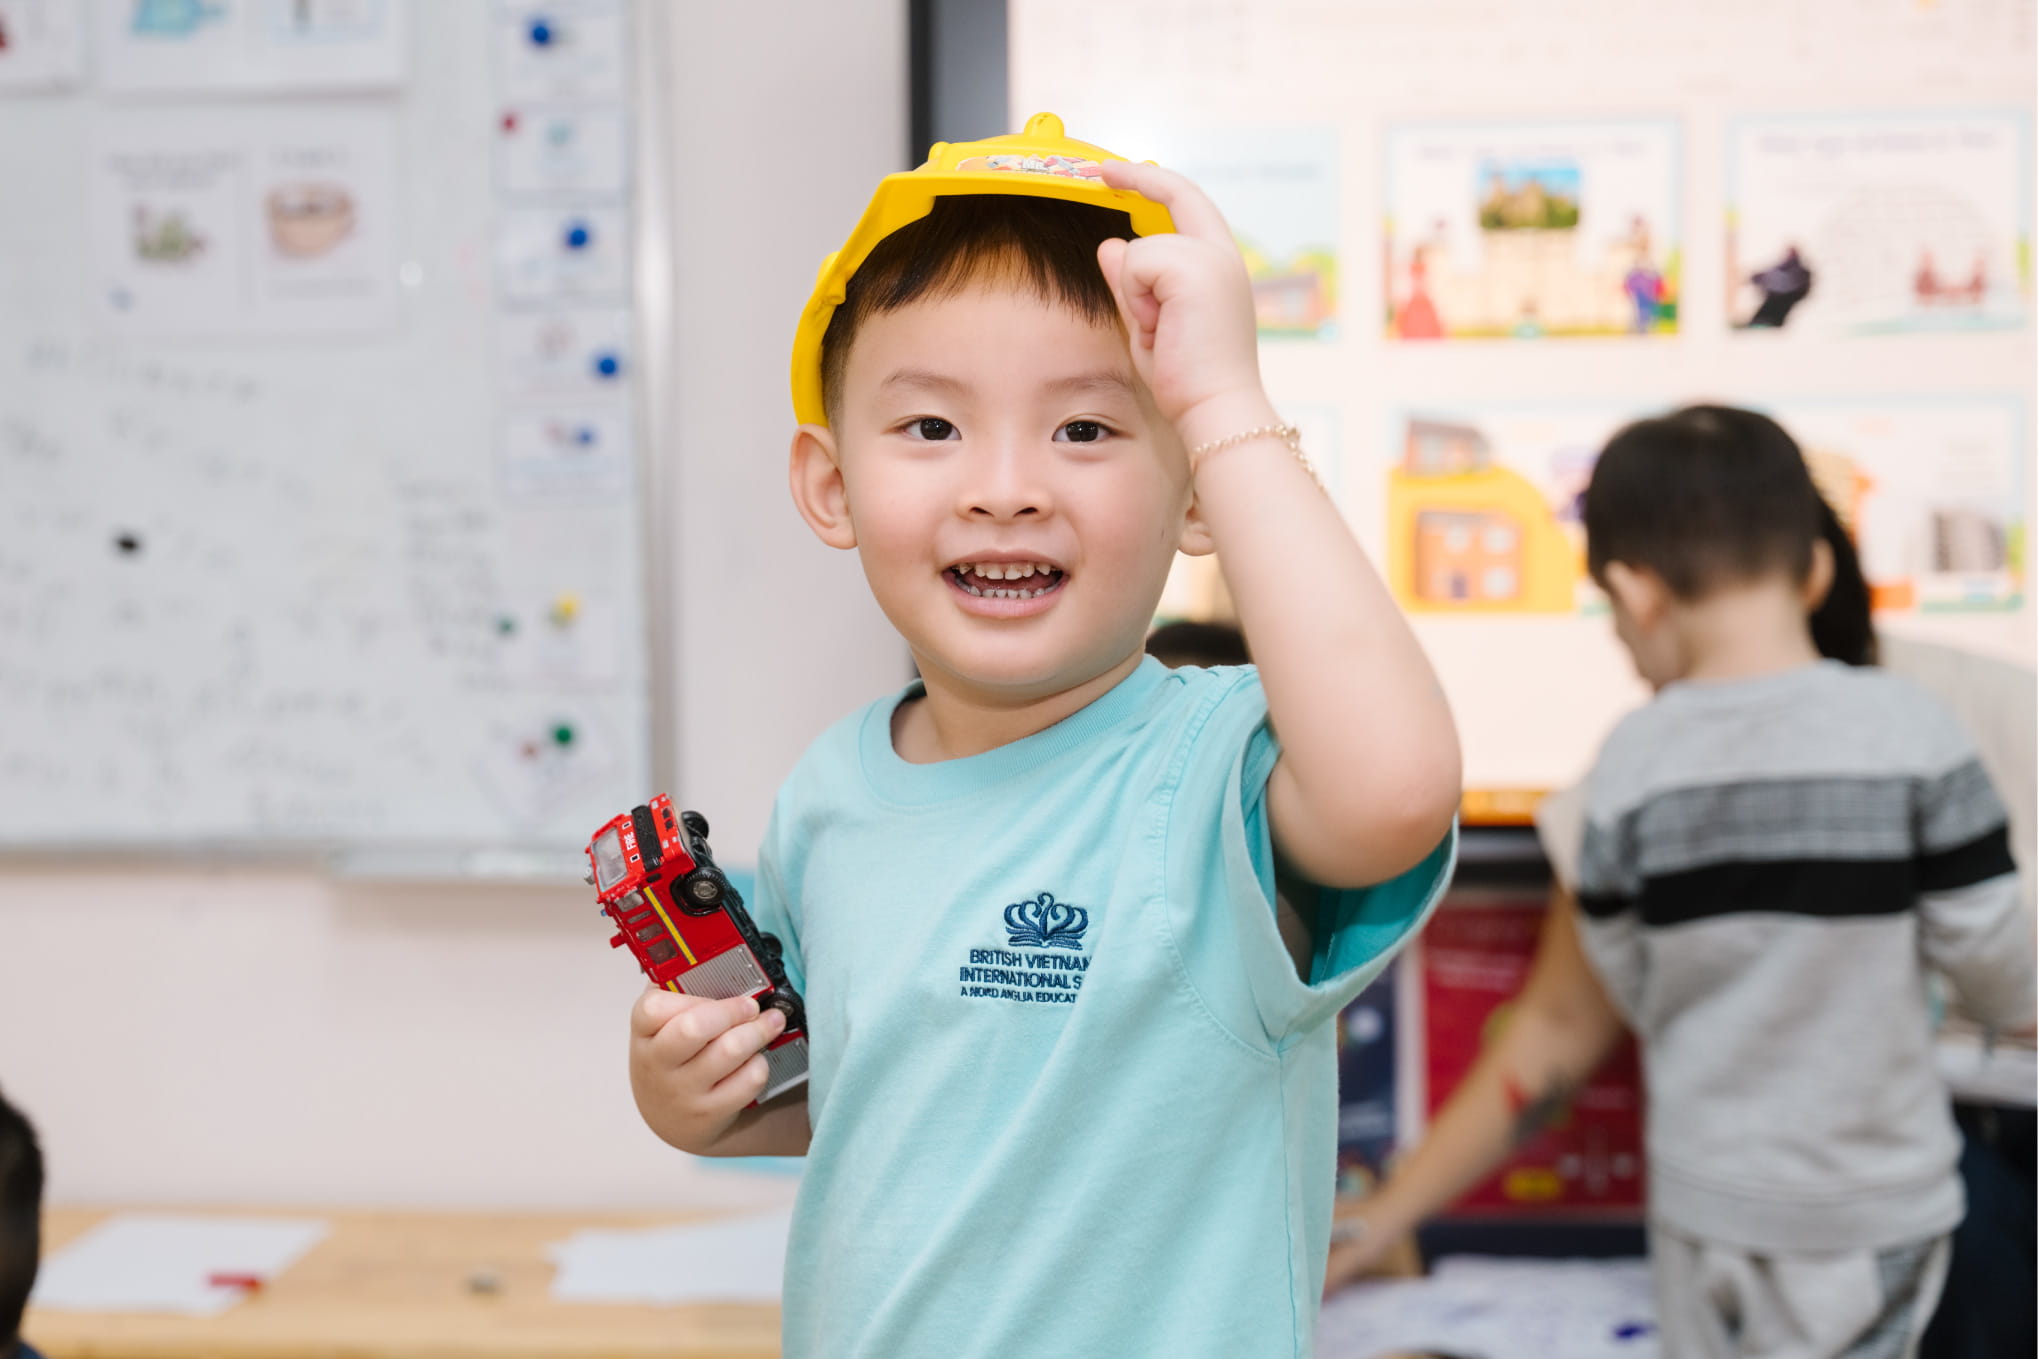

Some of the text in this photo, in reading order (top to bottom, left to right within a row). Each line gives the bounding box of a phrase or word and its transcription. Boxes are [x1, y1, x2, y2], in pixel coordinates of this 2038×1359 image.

[624, 831, 637, 851] FIRE
[970, 949, 1022, 967] BRITISH
[959, 966, 1071, 989] INTERNATIONAL
[960, 986, 968, 997] A
[970, 987, 999, 999] NORD
[1000, 990, 1034, 1003] ANGLIA
